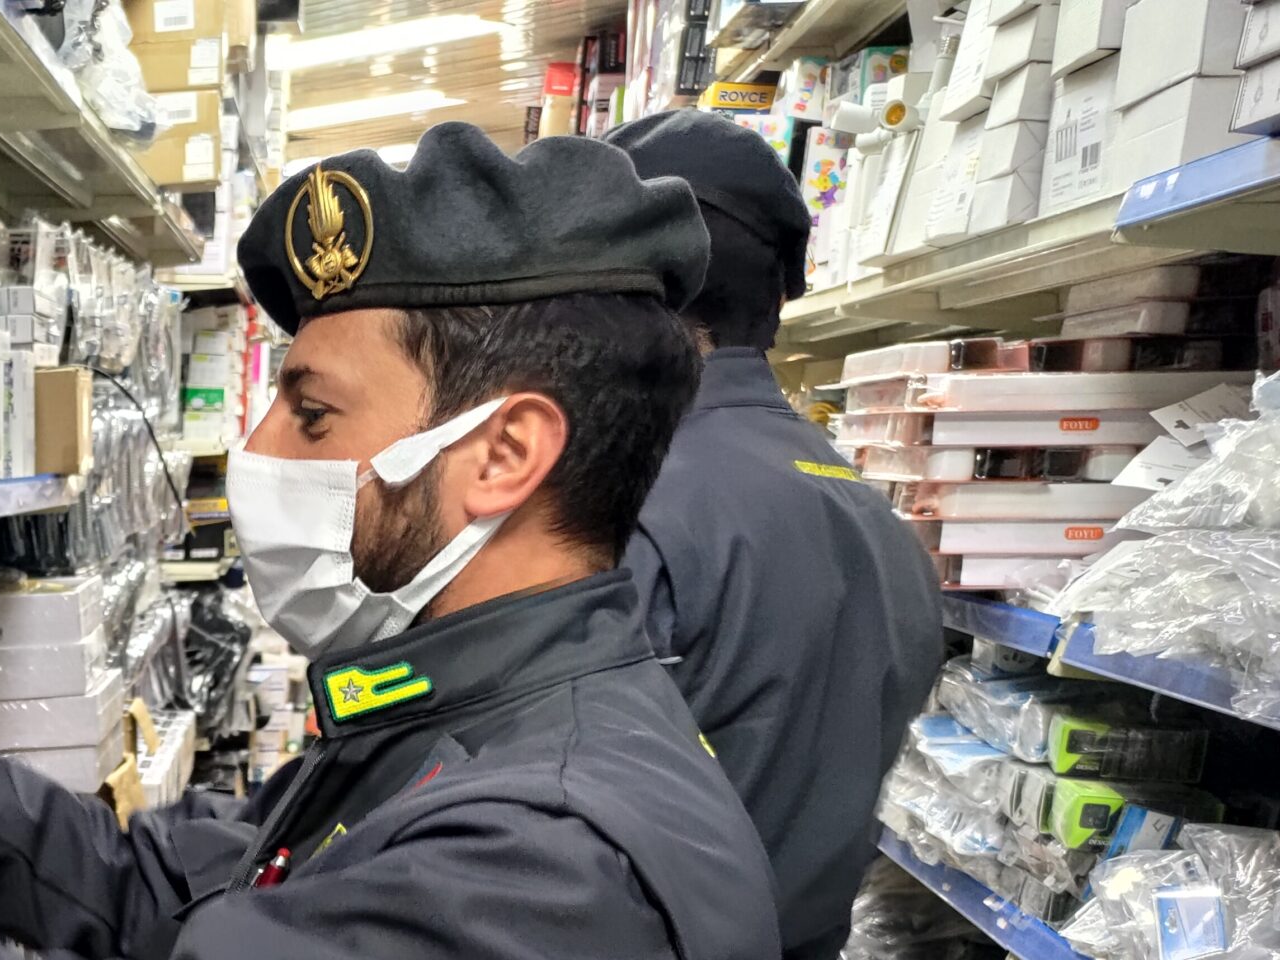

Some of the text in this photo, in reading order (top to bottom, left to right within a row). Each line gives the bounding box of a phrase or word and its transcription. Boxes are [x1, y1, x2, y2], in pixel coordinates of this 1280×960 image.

[719, 91, 768, 103] ROYCE
[1062, 419, 1093, 431] FOYU
[1067, 528, 1098, 539] FOYU
